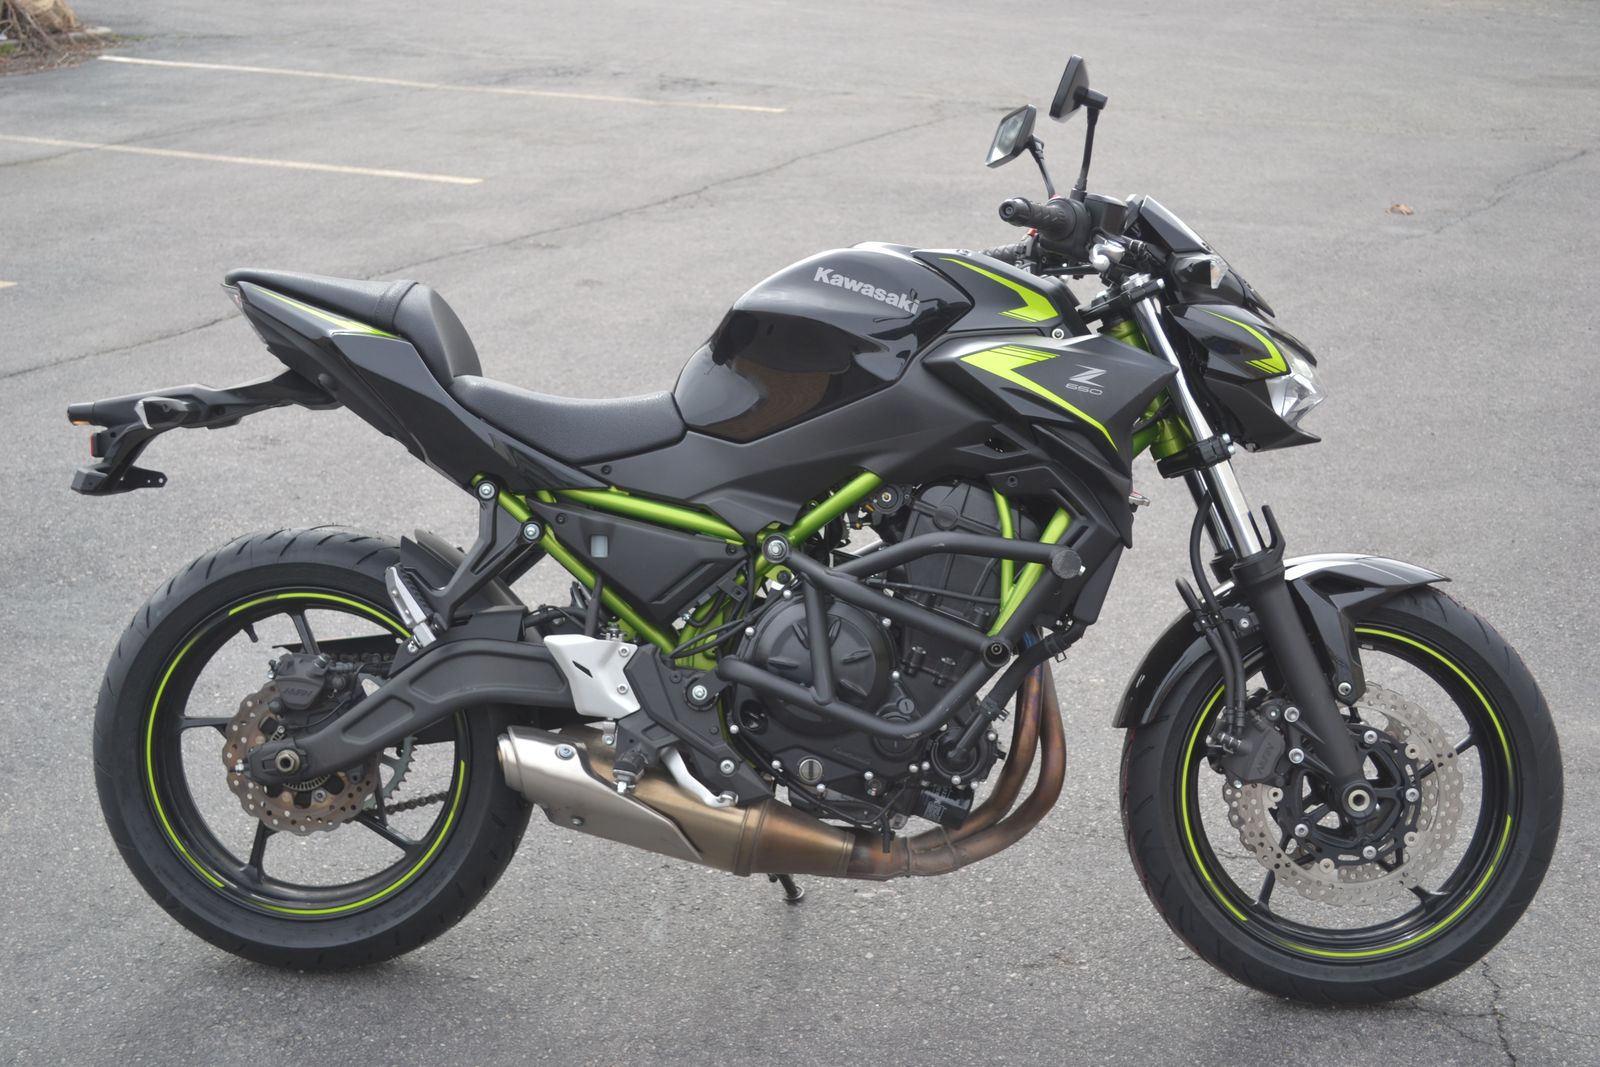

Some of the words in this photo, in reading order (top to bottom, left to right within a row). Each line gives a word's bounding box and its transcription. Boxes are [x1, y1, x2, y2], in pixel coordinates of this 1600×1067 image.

[813, 266, 920, 315] Kawasaki
[1068, 363, 1107, 388] Z
[1065, 382, 1103, 396] 650
